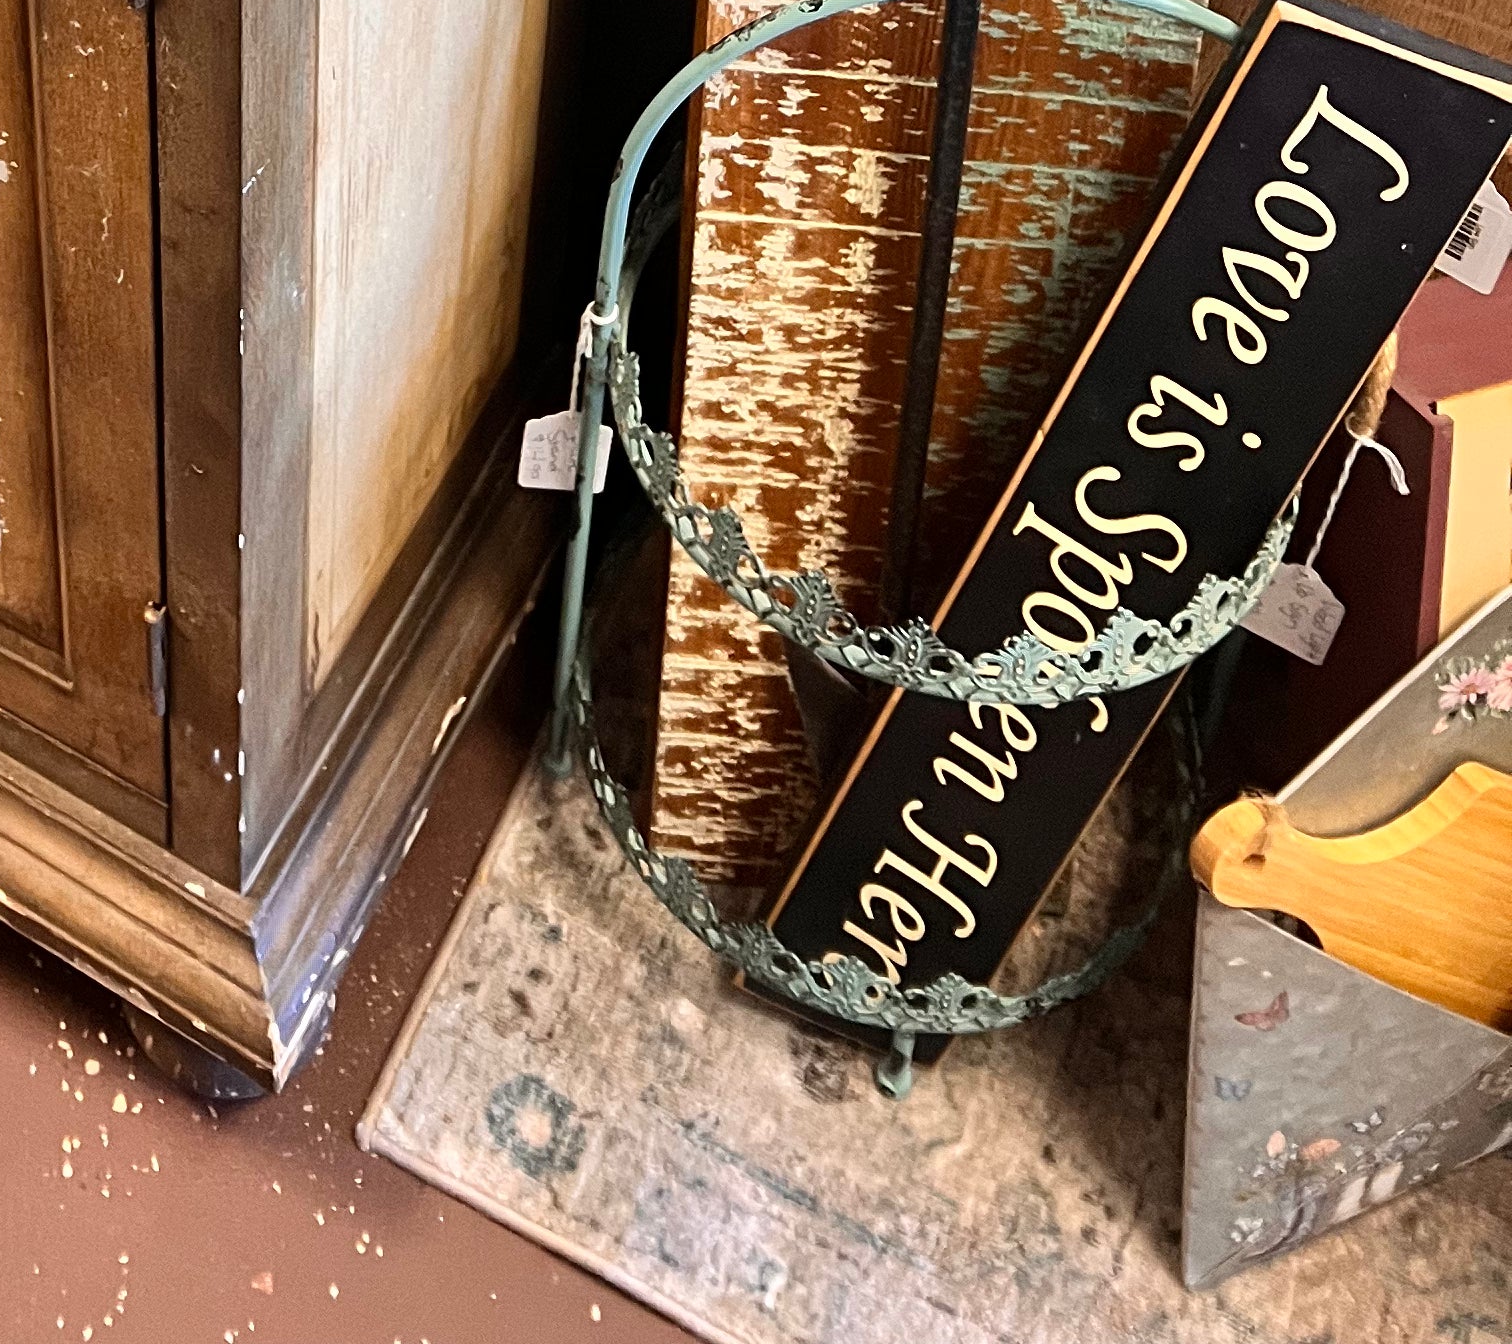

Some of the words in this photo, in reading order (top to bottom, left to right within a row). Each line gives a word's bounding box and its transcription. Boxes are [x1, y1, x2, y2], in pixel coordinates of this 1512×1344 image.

[1191, 84, 1410, 365] Love
[1127, 374, 1262, 472] is
[932, 465, 1188, 803] Spoen
[821, 799, 998, 1009] Her
